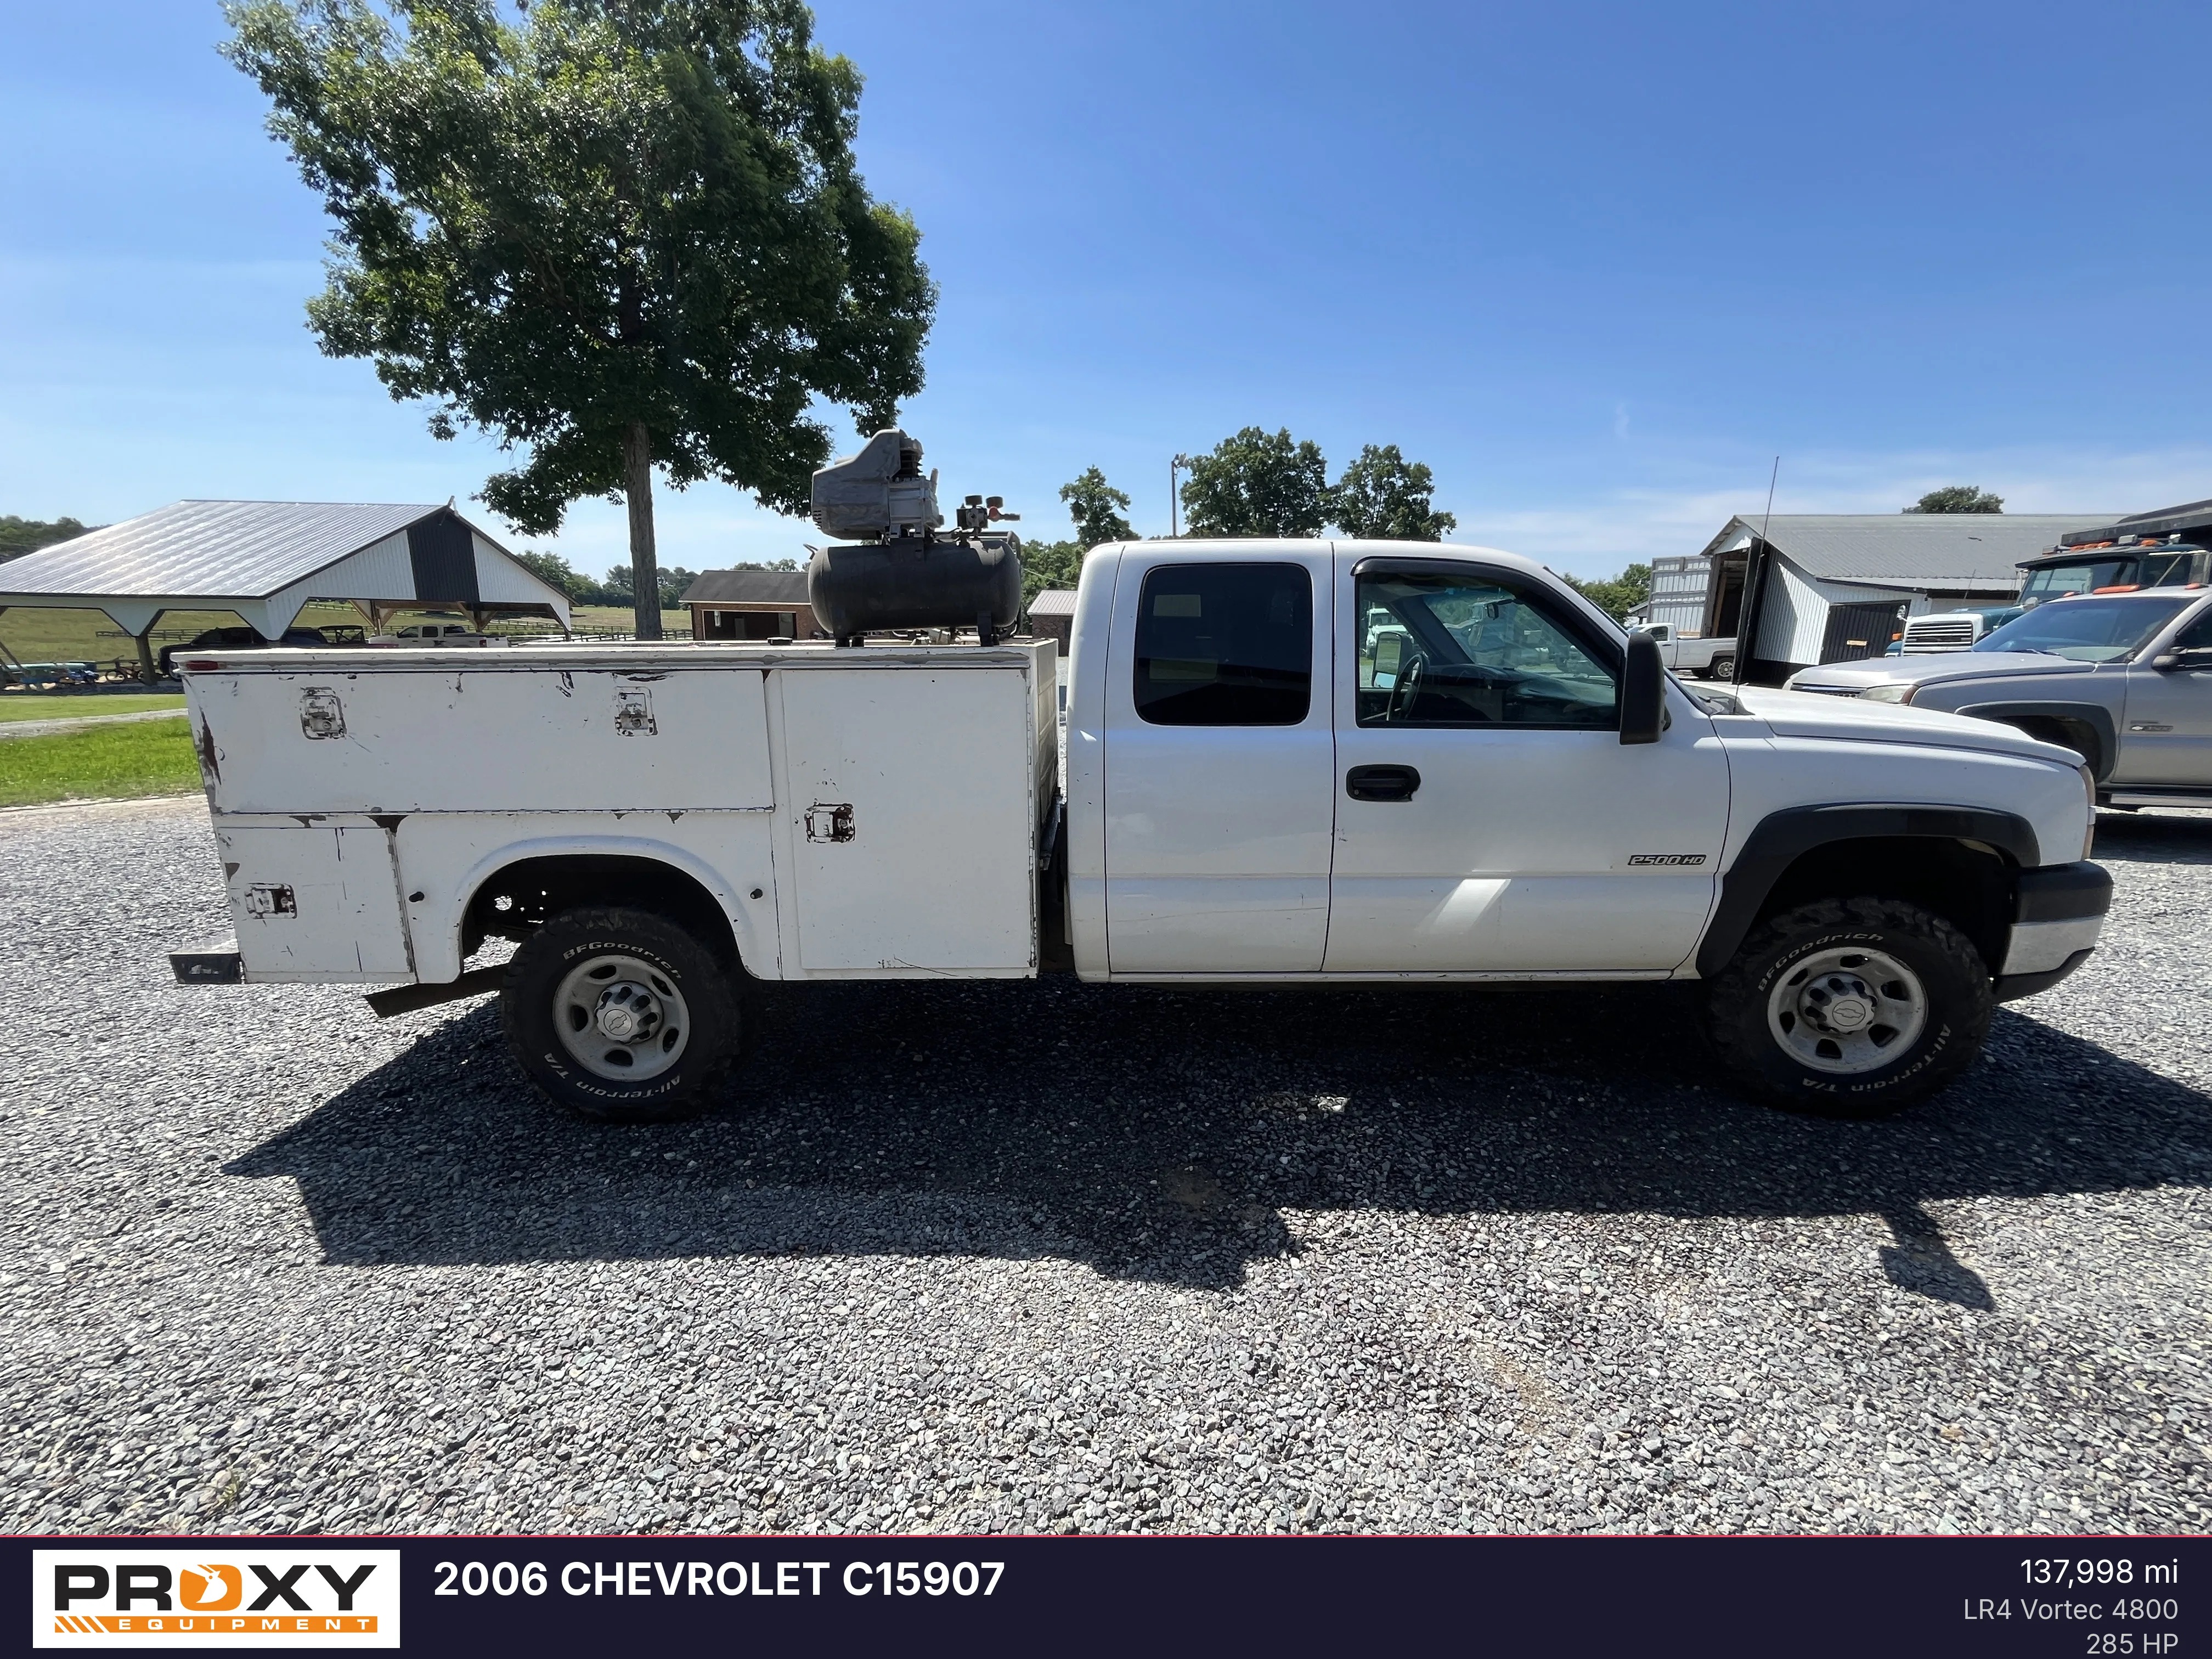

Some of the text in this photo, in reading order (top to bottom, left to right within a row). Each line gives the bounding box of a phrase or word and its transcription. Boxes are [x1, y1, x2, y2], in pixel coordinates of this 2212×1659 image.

[1630, 856, 1681, 865] 2500
[562, 941, 682, 979] BFGoodrich
[1757, 932, 1884, 992] BFGoodrich
[543, 1052, 681, 1098] All-Terrain T/A
[1802, 1023, 1951, 1092] All-Terrain T/A
